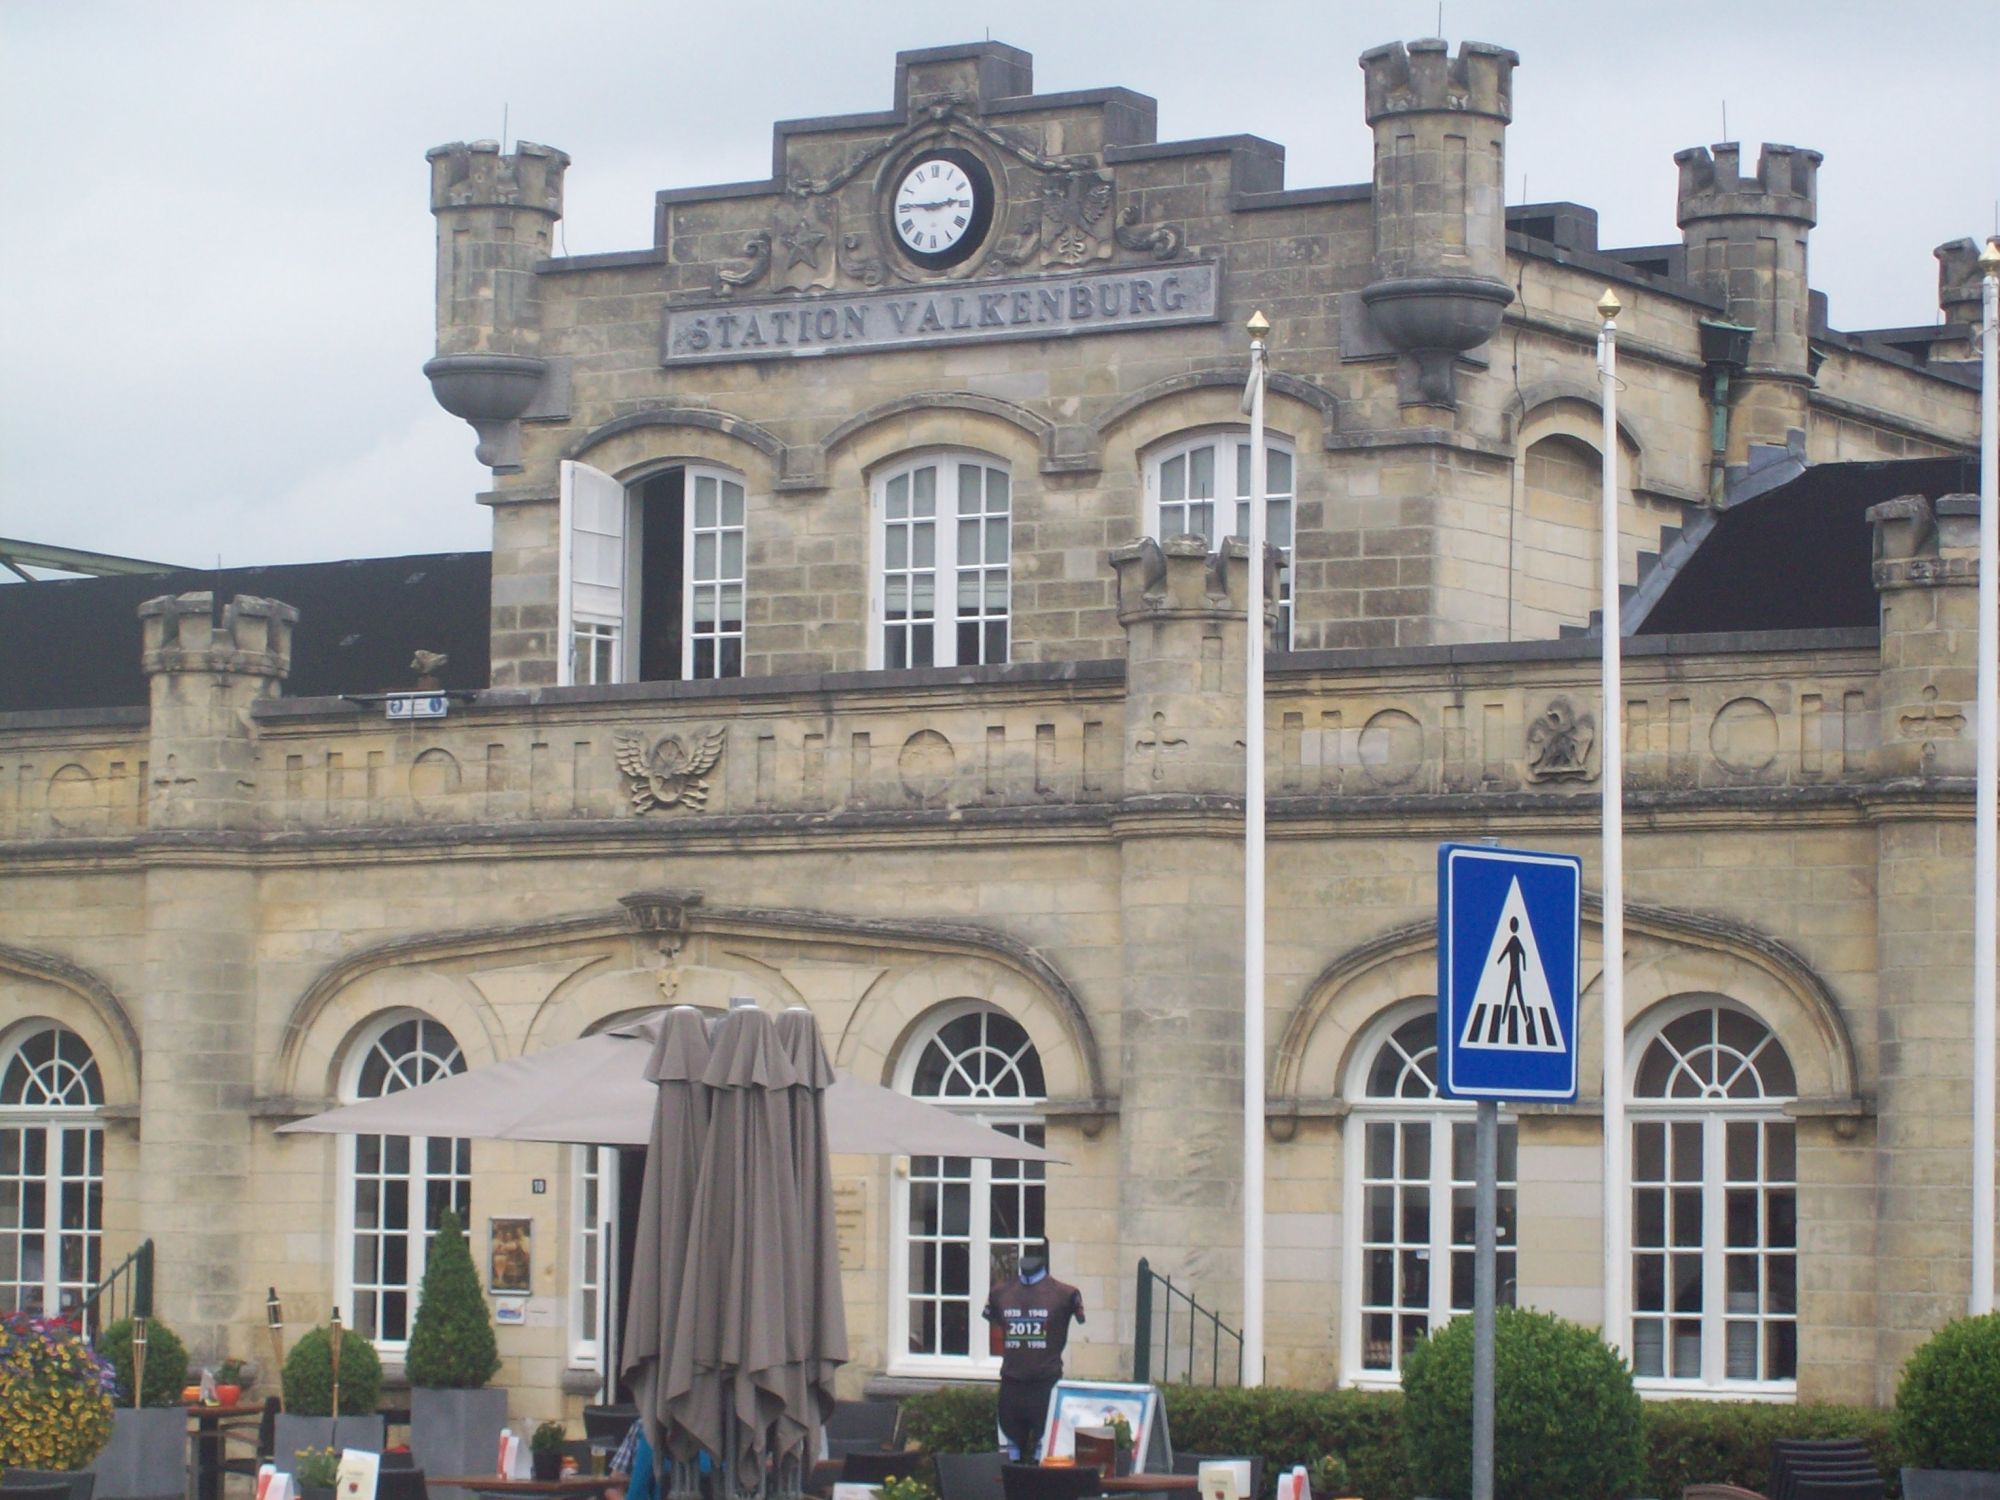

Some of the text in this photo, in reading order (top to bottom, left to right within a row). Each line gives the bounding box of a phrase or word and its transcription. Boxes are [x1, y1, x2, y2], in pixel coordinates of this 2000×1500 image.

[689, 277, 1187, 350] STATION VALKENBURG
[1009, 1322, 1041, 1335] 2012
